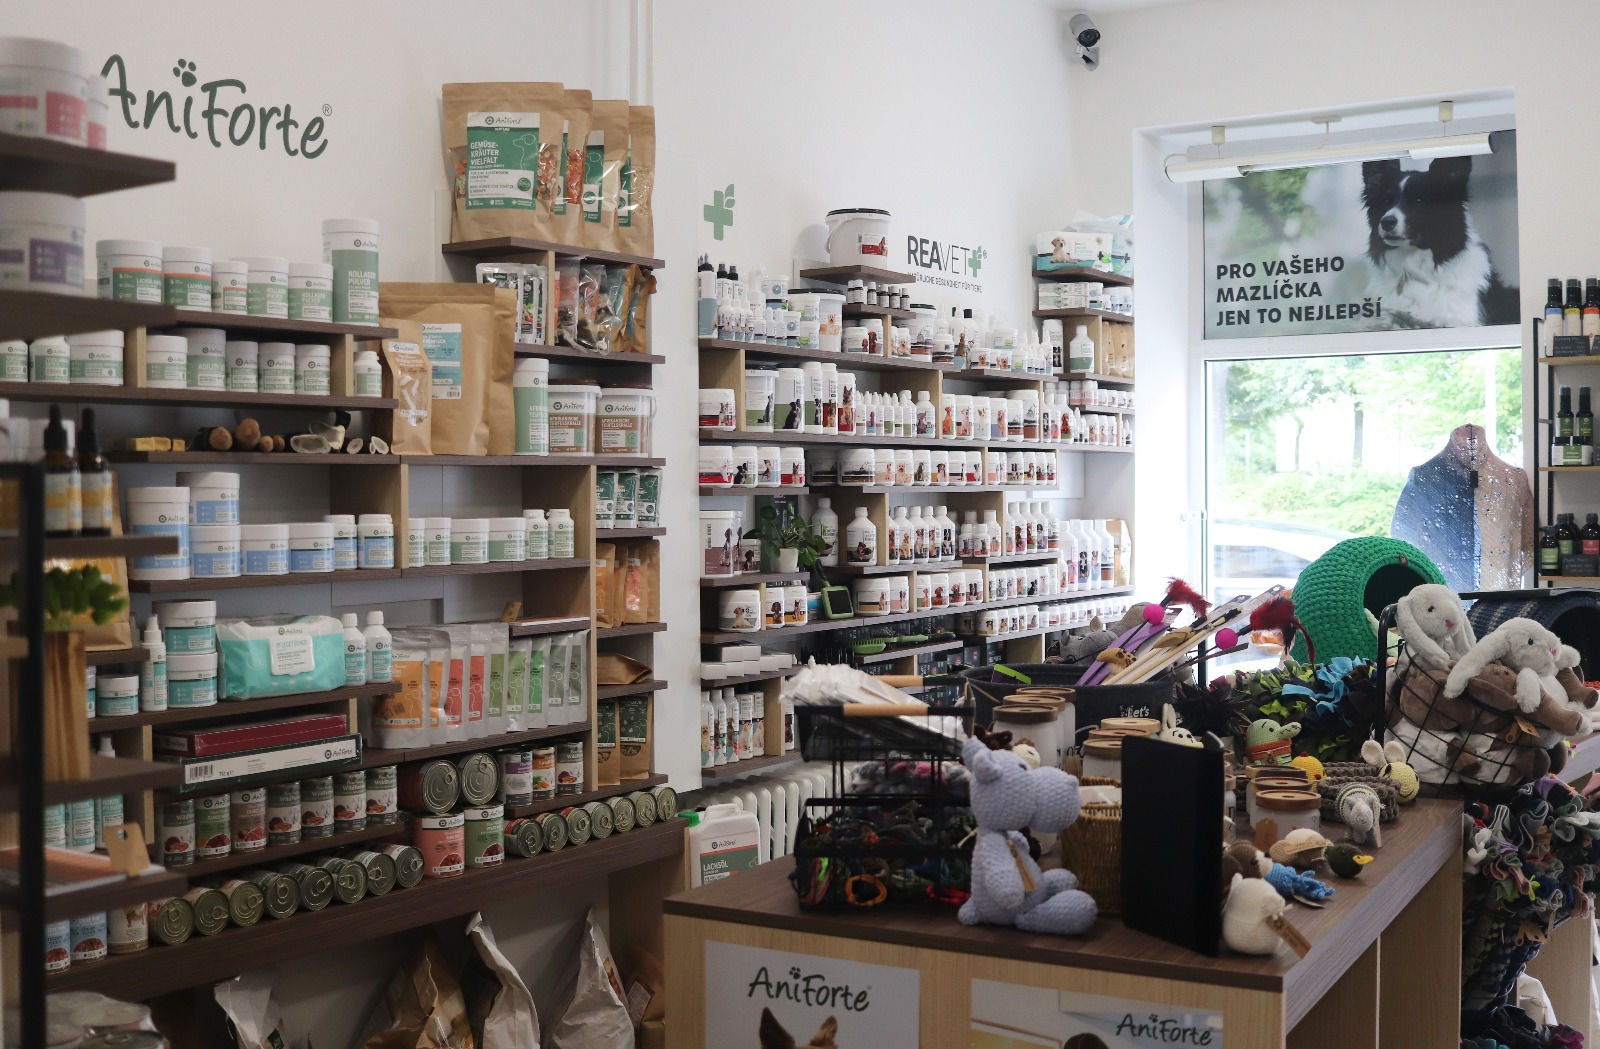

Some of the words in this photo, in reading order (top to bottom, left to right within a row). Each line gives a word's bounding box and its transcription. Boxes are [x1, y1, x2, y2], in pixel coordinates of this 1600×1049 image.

[470, 148, 499, 158] KRÄUTER
[470, 157, 498, 166] VIELFALT
[907, 235, 970, 275] REAVET
[1216, 262, 1256, 280] PRO
[1262, 254, 1345, 277] VAŠEHO
[348, 270, 377, 280] KOLLAGEN
[348, 278, 371, 287] PULVER
[1216, 278, 1323, 303] MAZLÍČKA
[1216, 309, 1250, 327] JEN
[1257, 307, 1282, 324] TO
[1289, 296, 1382, 322] NEJLEPŠÍ
[703, 859, 729, 872] LACHSÖL
[748, 966, 870, 1012] AniForte
[1116, 1013, 1212, 1046] AniForte
